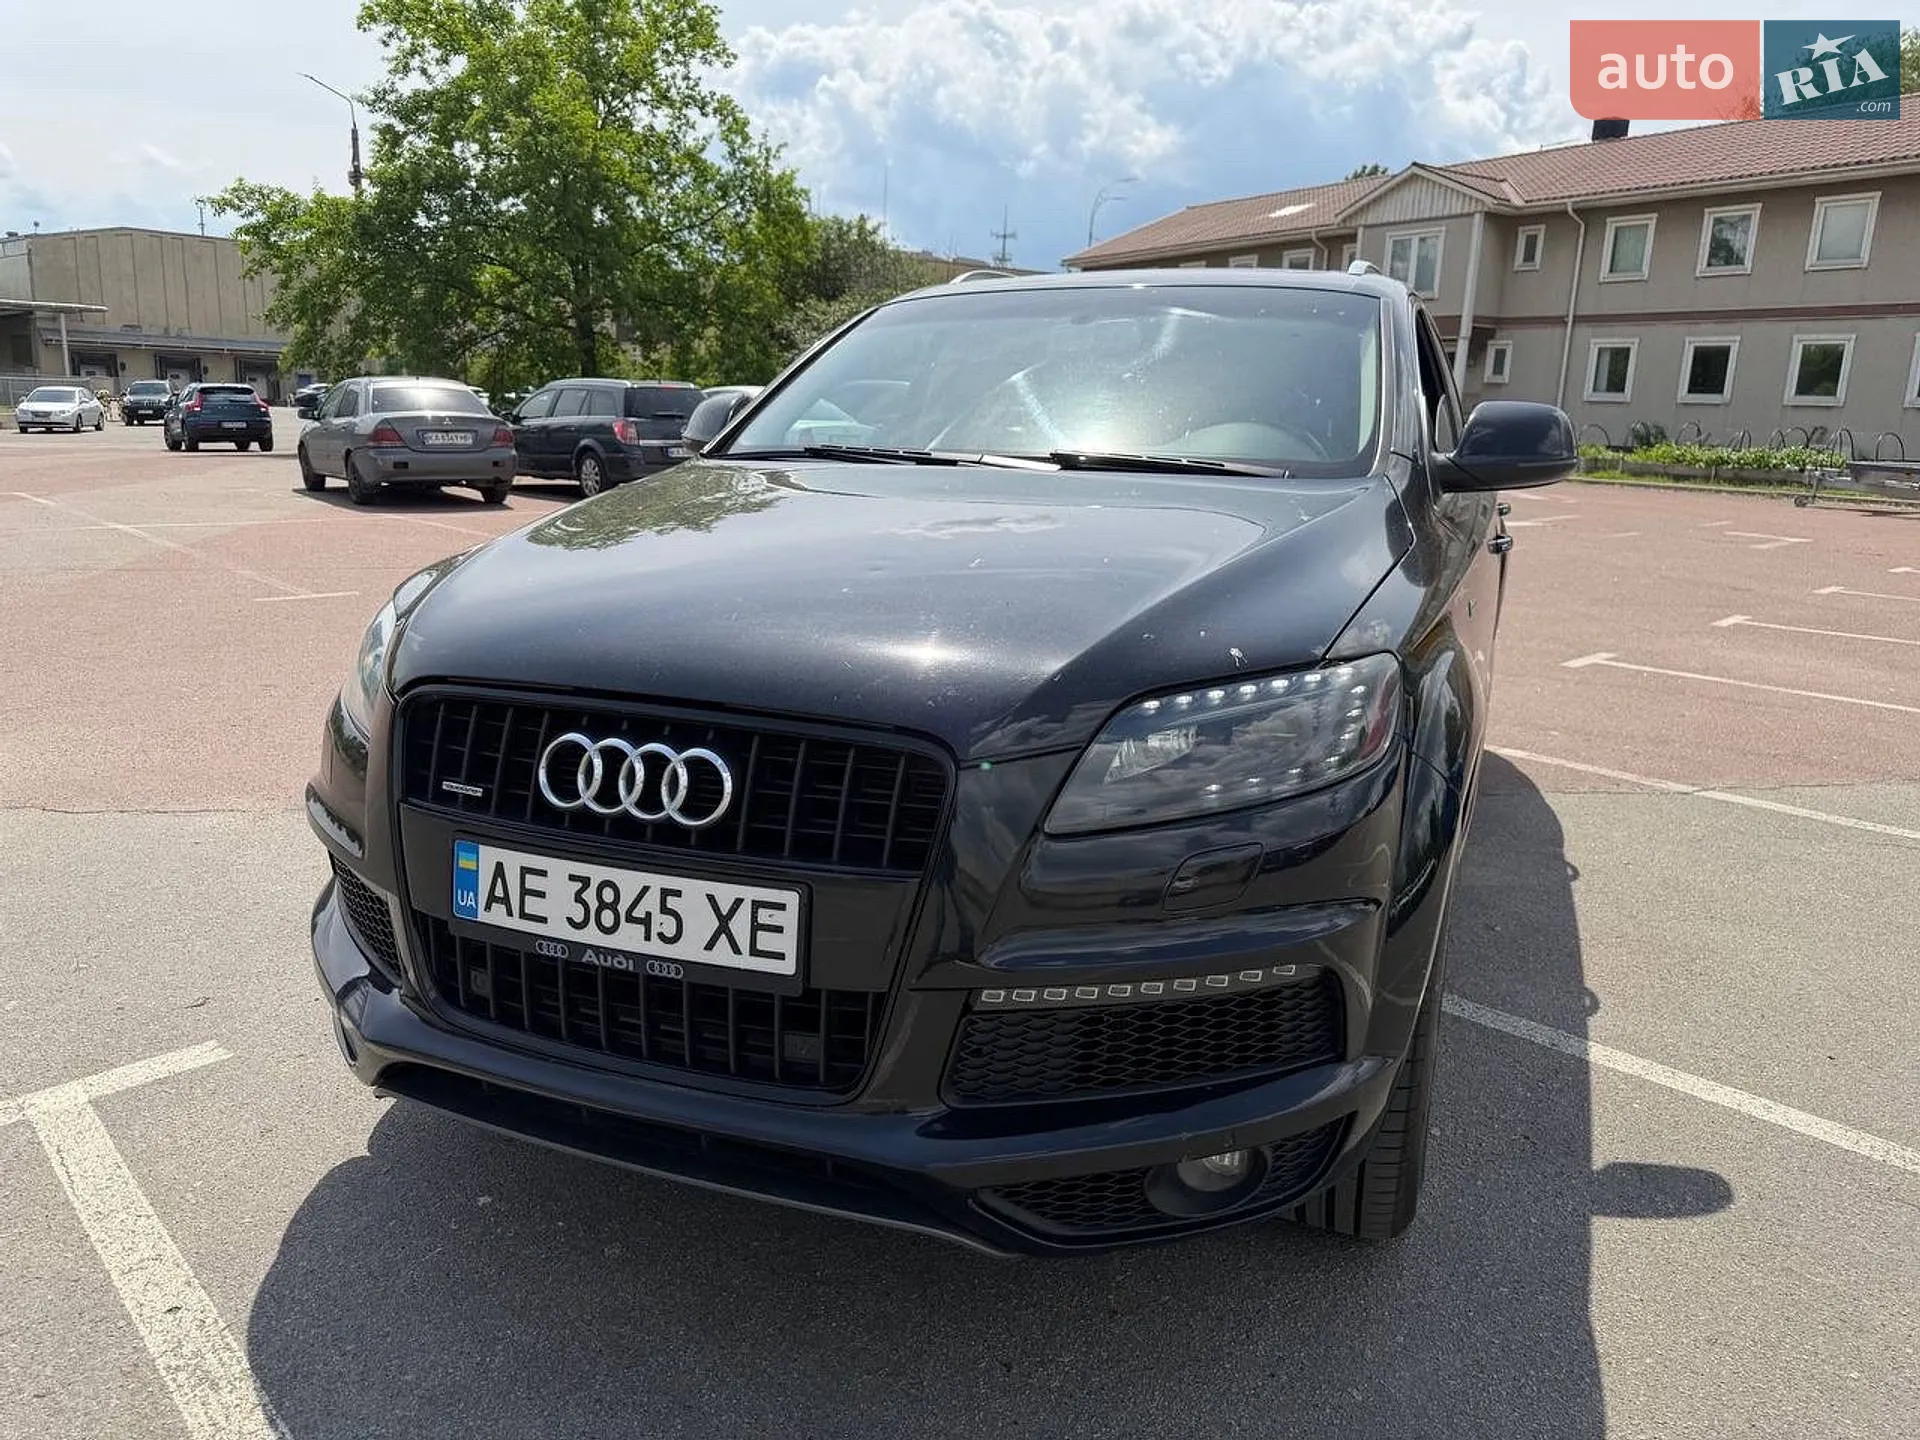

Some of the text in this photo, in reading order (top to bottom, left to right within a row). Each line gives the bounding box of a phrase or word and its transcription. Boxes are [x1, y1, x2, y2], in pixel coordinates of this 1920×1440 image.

[457, 889, 477, 909] UA
[484, 861, 788, 961] AE 3845 XE
[581, 949, 635, 972] Audi
